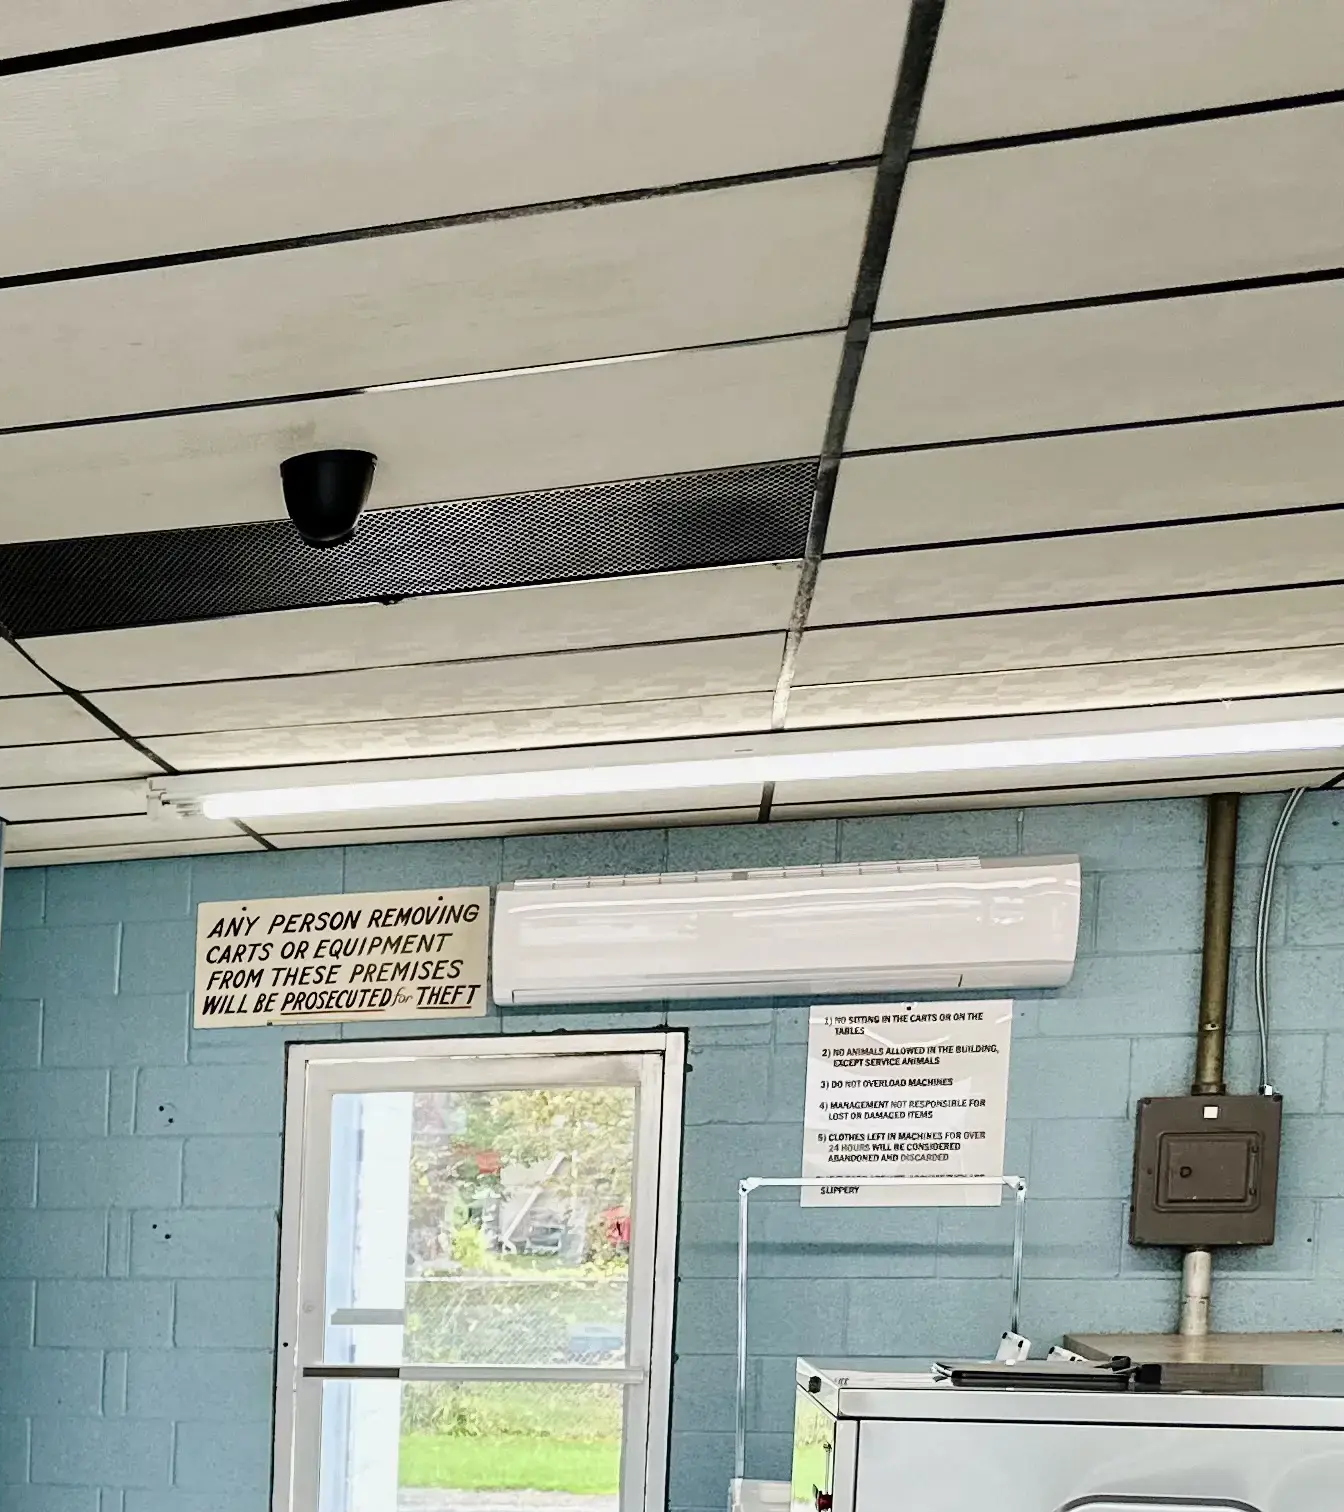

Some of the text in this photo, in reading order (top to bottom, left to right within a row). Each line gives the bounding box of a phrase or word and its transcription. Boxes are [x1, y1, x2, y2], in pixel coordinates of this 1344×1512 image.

[207, 904, 480, 938] ANY PERSON REMOVING
[206, 933, 453, 963] CARTS OR EQUIPMENT
[206, 960, 464, 990] FROM THESE PREMISES
[202, 985, 481, 1015] WILL BE PROSECUTED for THEFT
[835, 1016, 846, 1024] NO
[882, 1015, 891, 1023] IN
[892, 1015, 908, 1023] THE
[910, 1014, 937, 1022] CARTS
[953, 1013, 965, 1021] ON
[967, 1012, 983, 1020] THE
[835, 1027, 865, 1035] TABLES
[822, 1048, 830, 1056] 2)
[833, 1048, 844, 1056] NO
[846, 1047, 883, 1055] ANIMALS
[885, 1047, 925, 1055] ALLOWED
[938, 1046, 954, 1054] THE
[833, 1057, 940, 1067] EXCEPT SERVICE ANIMALS
[821, 1078, 953, 1089] 3) DO NOT OVERLOAD MACHINES
[820, 1102, 828, 1110] 4)
[830, 1101, 889, 1109] MANAGEMENT
[891, 1100, 906, 1108] NOT
[909, 1100, 966, 1108] RESPONSIBLE
[829, 1111, 933, 1120] LOST OR DAMAGED ITEMS
[829, 1133, 865, 1141] CLOTHES
[867, 1133, 885, 1141] LEFT
[898, 1132, 942, 1140] MACHINES
[945, 1132, 961, 1140] FOR
[964, 1131, 985, 1139] OVER
[842, 1144, 870, 1152] HOURS
[872, 1143, 892, 1151] WILL
[894, 1143, 904, 1151] BE
[906, 1143, 961, 1151] CONSIDERED
[828, 1153, 949, 1162] ABANDONED AND DISCARDED
[820, 1186, 859, 1195] SLIPPERY
